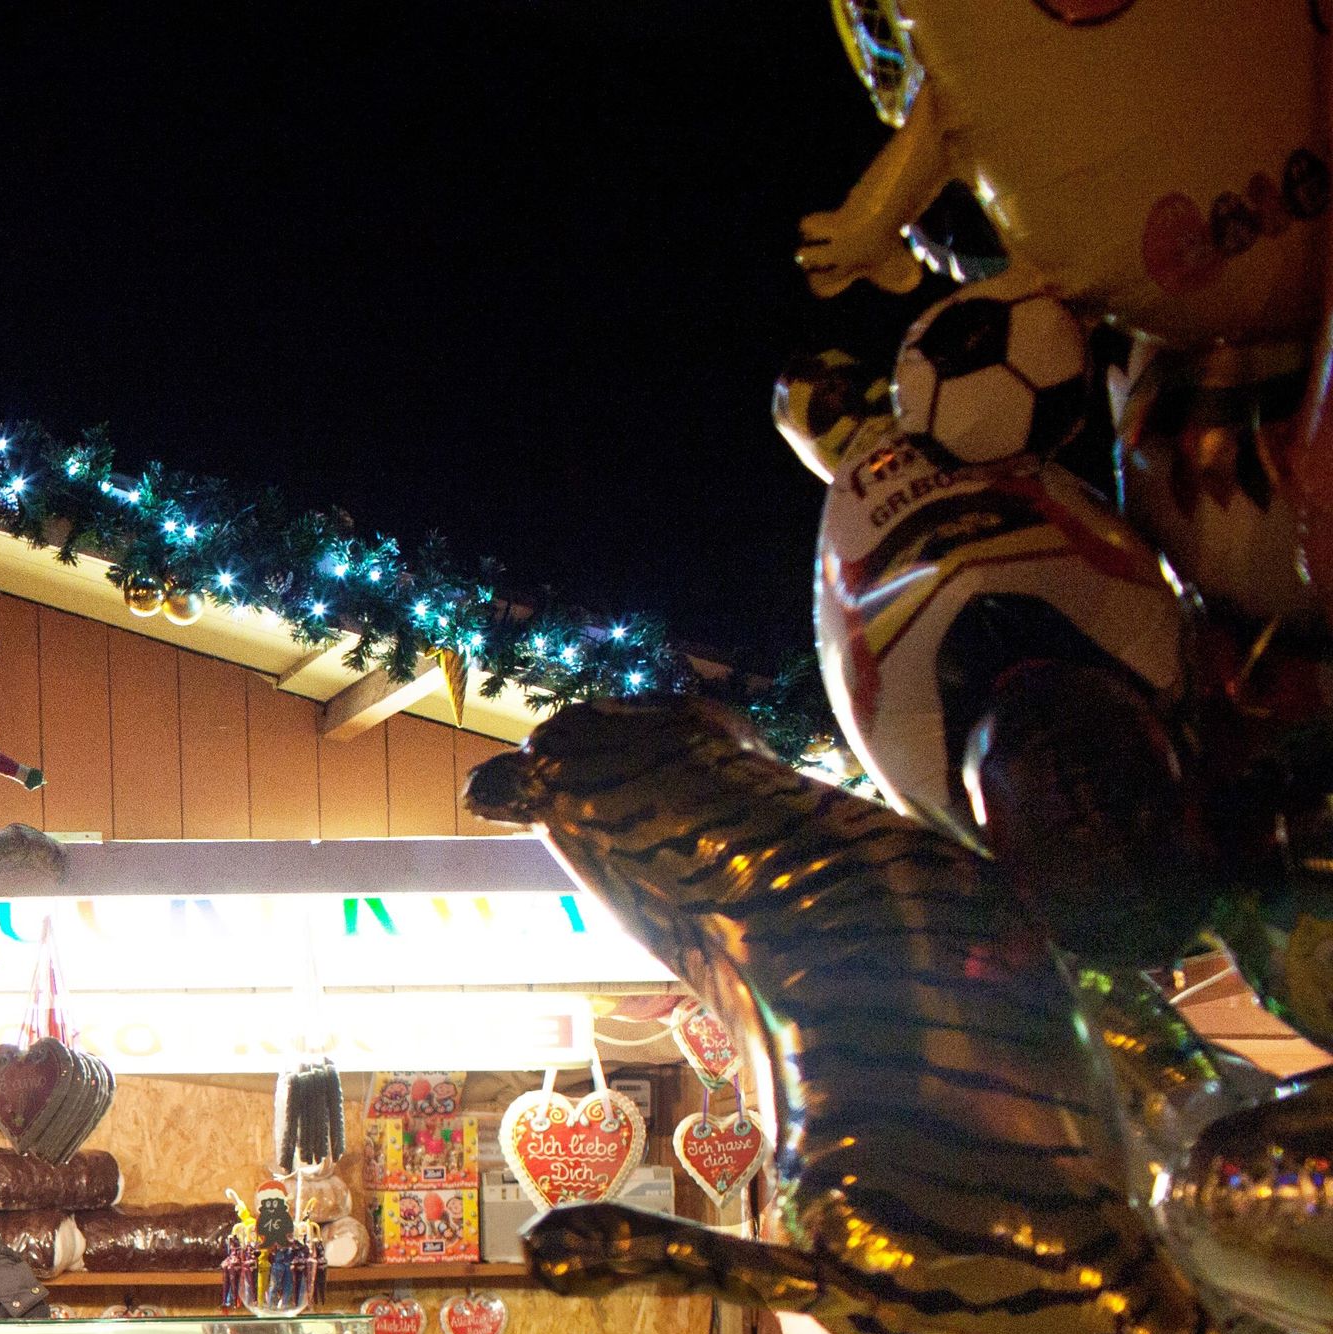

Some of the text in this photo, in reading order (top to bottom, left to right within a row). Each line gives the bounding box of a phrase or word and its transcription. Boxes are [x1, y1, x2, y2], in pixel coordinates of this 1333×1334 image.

[526, 1132, 618, 1157] Ich liebe
[687, 1139, 713, 1156] Ich
[703, 1153, 736, 1168] dich
[550, 1161, 597, 1182] Dich
[263, 1218, 282, 1232] 1€
